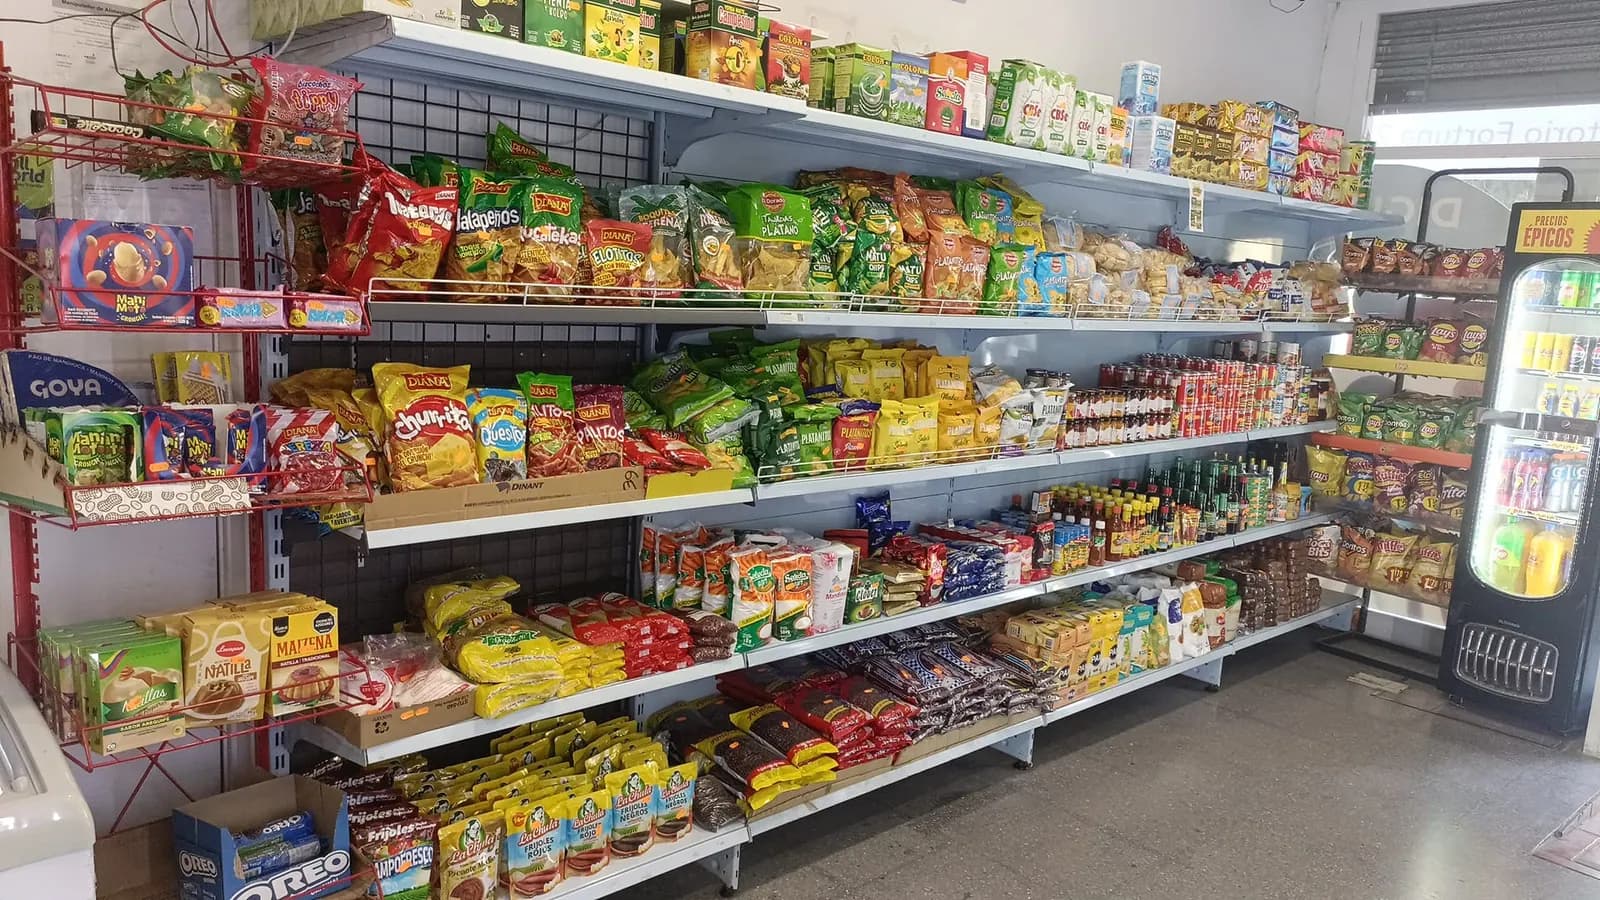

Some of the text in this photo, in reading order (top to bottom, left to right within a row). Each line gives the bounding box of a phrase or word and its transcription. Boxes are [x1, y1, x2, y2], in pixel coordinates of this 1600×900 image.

[291, 89, 340, 114] tippy
[534, 196, 571, 216] DIANA
[1535, 215, 1569, 227] PRECIOS
[603, 230, 633, 244] DIANA
[1522, 223, 1575, 249] ÉPICOS
[591, 247, 643, 266] ELOTITOS
[866, 249, 887, 262] MATU
[116, 293, 147, 307] Mani
[116, 302, 147, 313] Moto
[30, 378, 102, 399] GOYA
[406, 374, 451, 388] DIANA
[580, 407, 609, 420] DIANA
[1337, 414, 1356, 423] oritos
[286, 426, 317, 437] DIANA
[577, 425, 624, 447] PALITOS
[1374, 469, 1411, 482] Ruffles
[512, 482, 545, 491] DINANT
[1341, 540, 1368, 555] Doritos
[784, 570, 809, 583] Selecta
[279, 653, 331, 668] NATILLA TRADICIONAL
[120, 722, 142, 733] SABOR
[615, 784, 653, 809] La Chula
[665, 792, 687, 803] FRIJOLES
[665, 798, 688, 810] NEGROS
[572, 808, 606, 831] La Chula
[619, 808, 649, 823] NEGROS
[263, 816, 302, 834] OREO
[517, 818, 561, 847] La Chula
[367, 824, 416, 844] Frijoles
[449, 848, 468, 866] La
[526, 845, 553, 860] ROJOS
[181, 852, 217, 876] OREO
[374, 846, 434, 881] AMPOFRESCO
